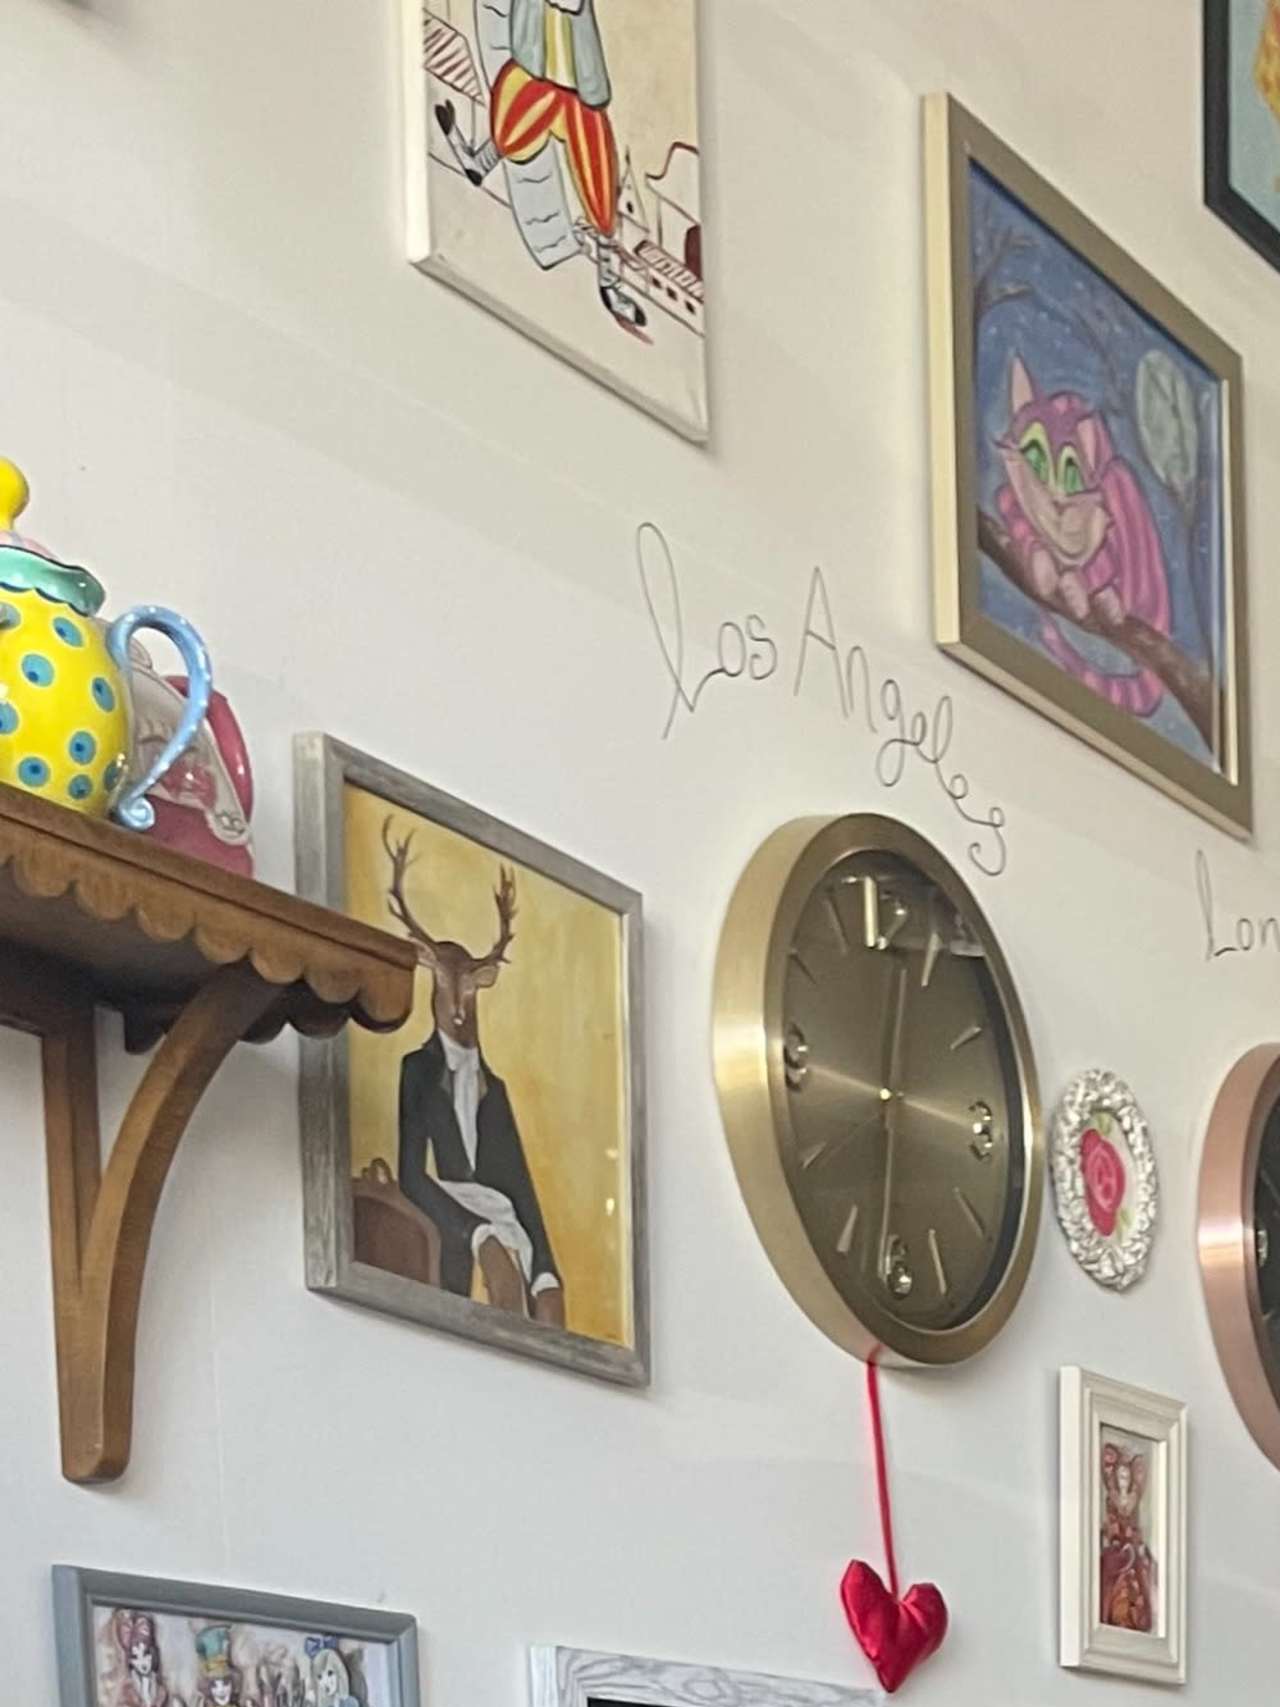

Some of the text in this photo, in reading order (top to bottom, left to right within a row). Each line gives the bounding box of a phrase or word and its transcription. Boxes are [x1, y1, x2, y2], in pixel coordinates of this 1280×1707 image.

[637, 522, 1007, 877] Los Angeles
[967, 1100, 993, 1162] 3
